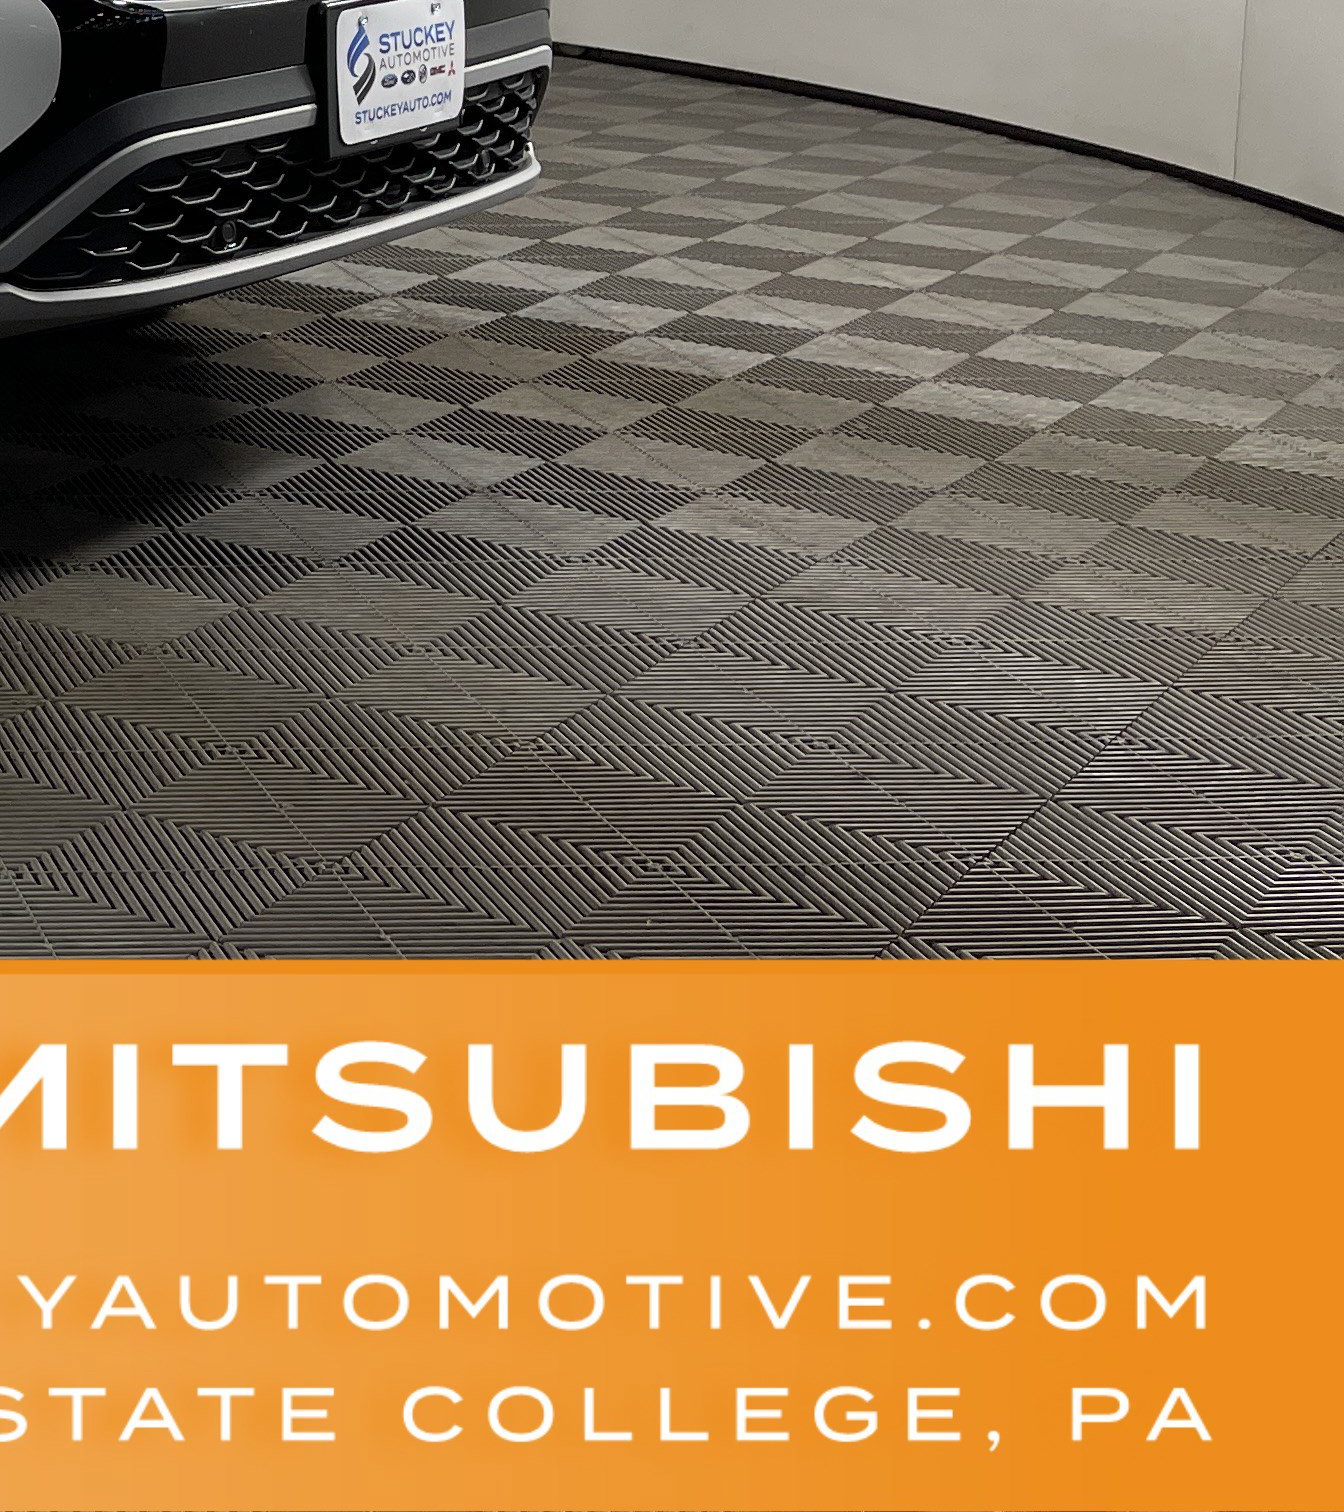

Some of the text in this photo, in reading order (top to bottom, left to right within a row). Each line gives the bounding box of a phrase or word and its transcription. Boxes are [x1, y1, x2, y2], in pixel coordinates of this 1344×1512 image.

[379, 20, 455, 54] STUCKEY
[379, 42, 455, 71] AUTOMOTIVE
[354, 90, 452, 124] STUCKEYAUTO.COM
